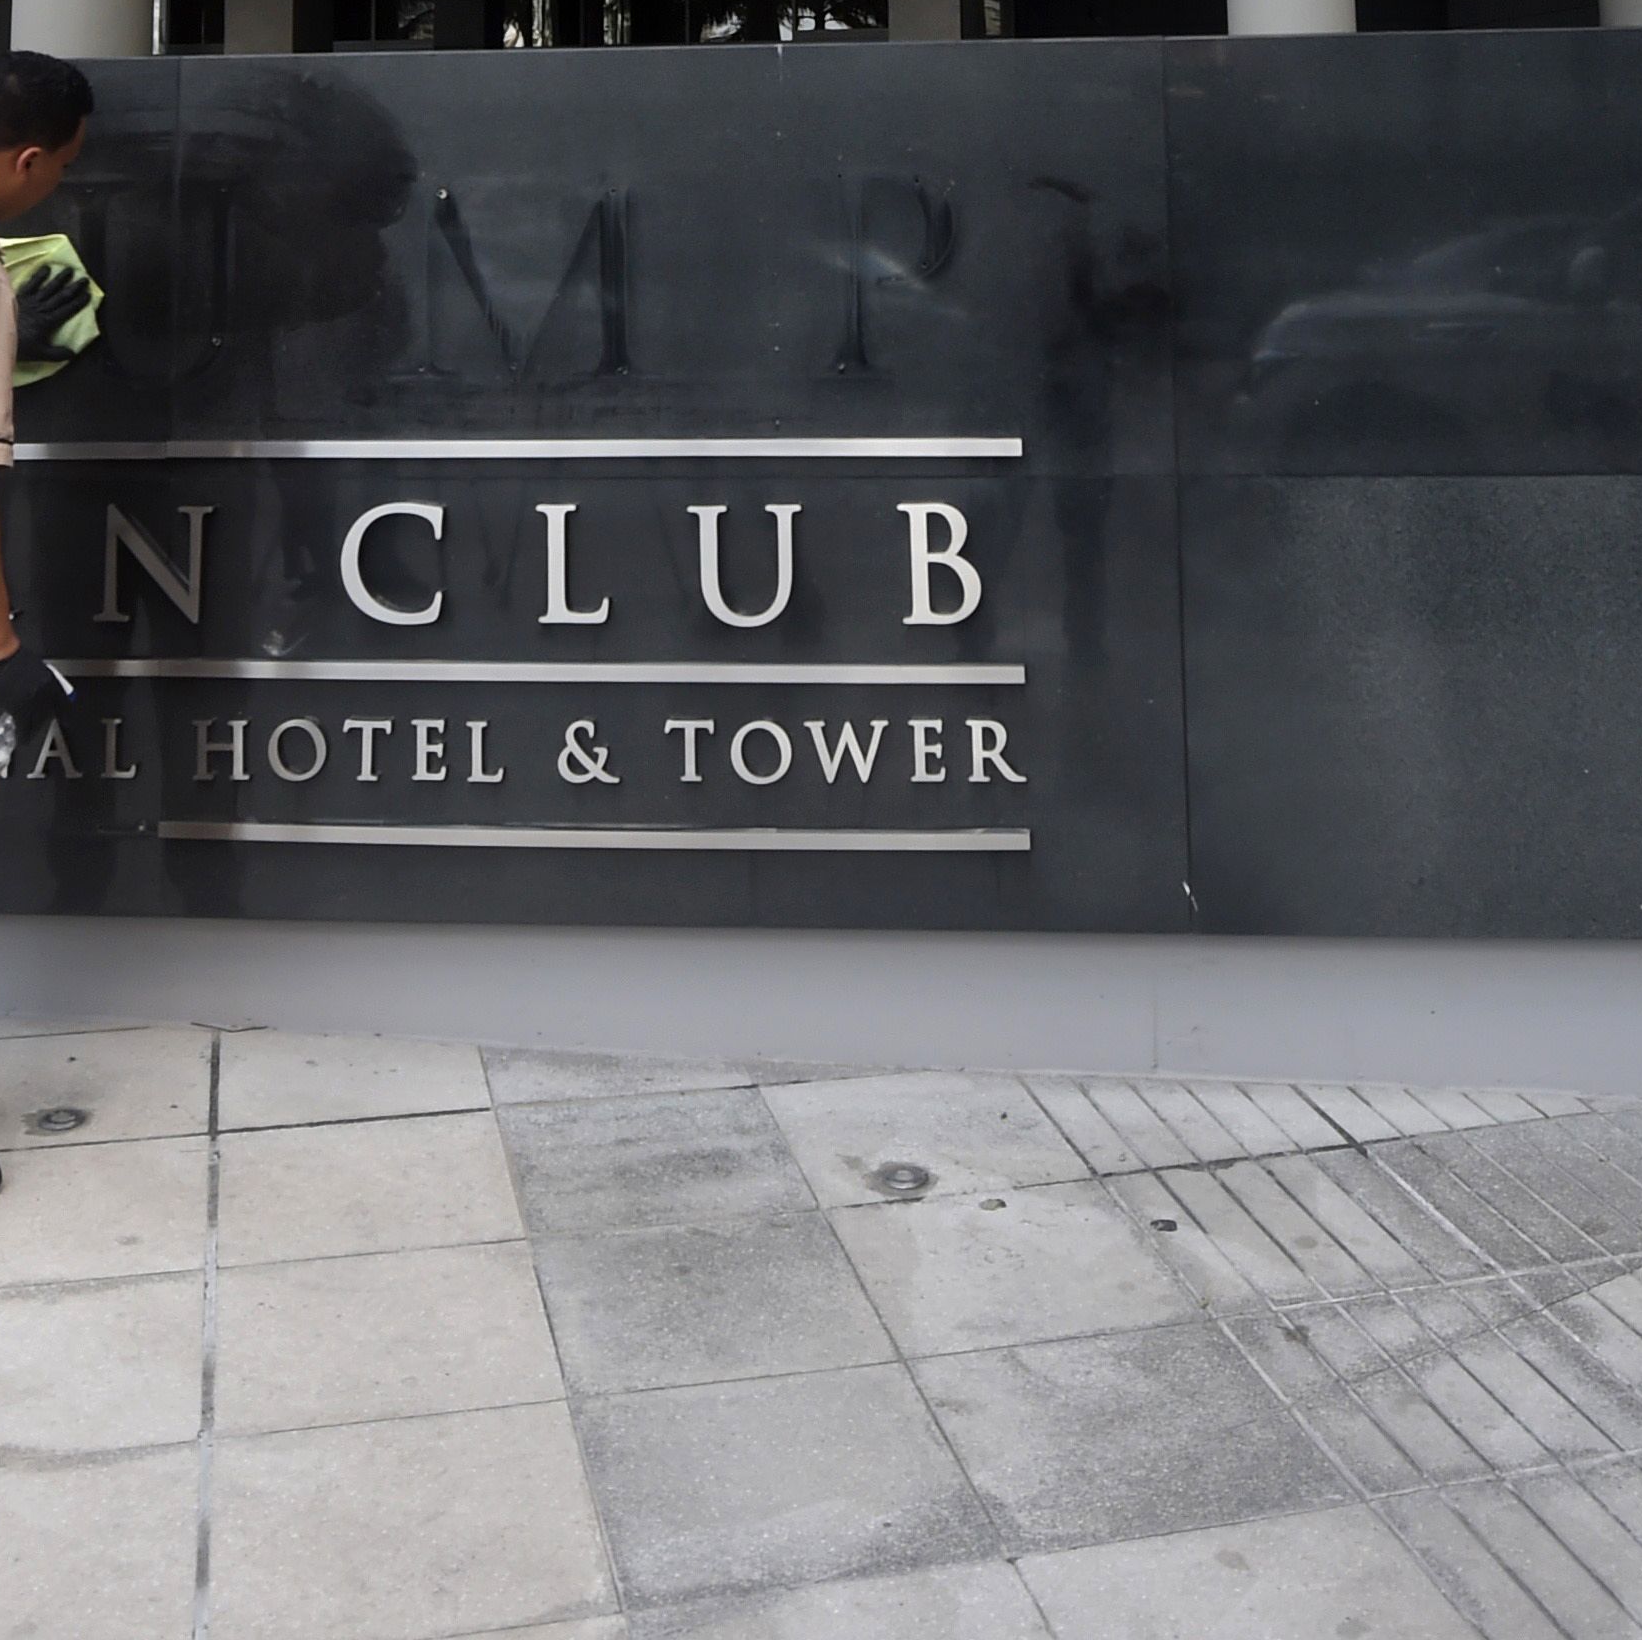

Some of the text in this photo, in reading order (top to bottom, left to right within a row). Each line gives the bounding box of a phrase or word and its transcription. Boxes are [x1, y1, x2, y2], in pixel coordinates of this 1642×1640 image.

[340, 502, 982, 628] CLUB
[193, 718, 504, 783] HOTEL
[557, 719, 620, 784] &
[664, 718, 1027, 785] TOWER
